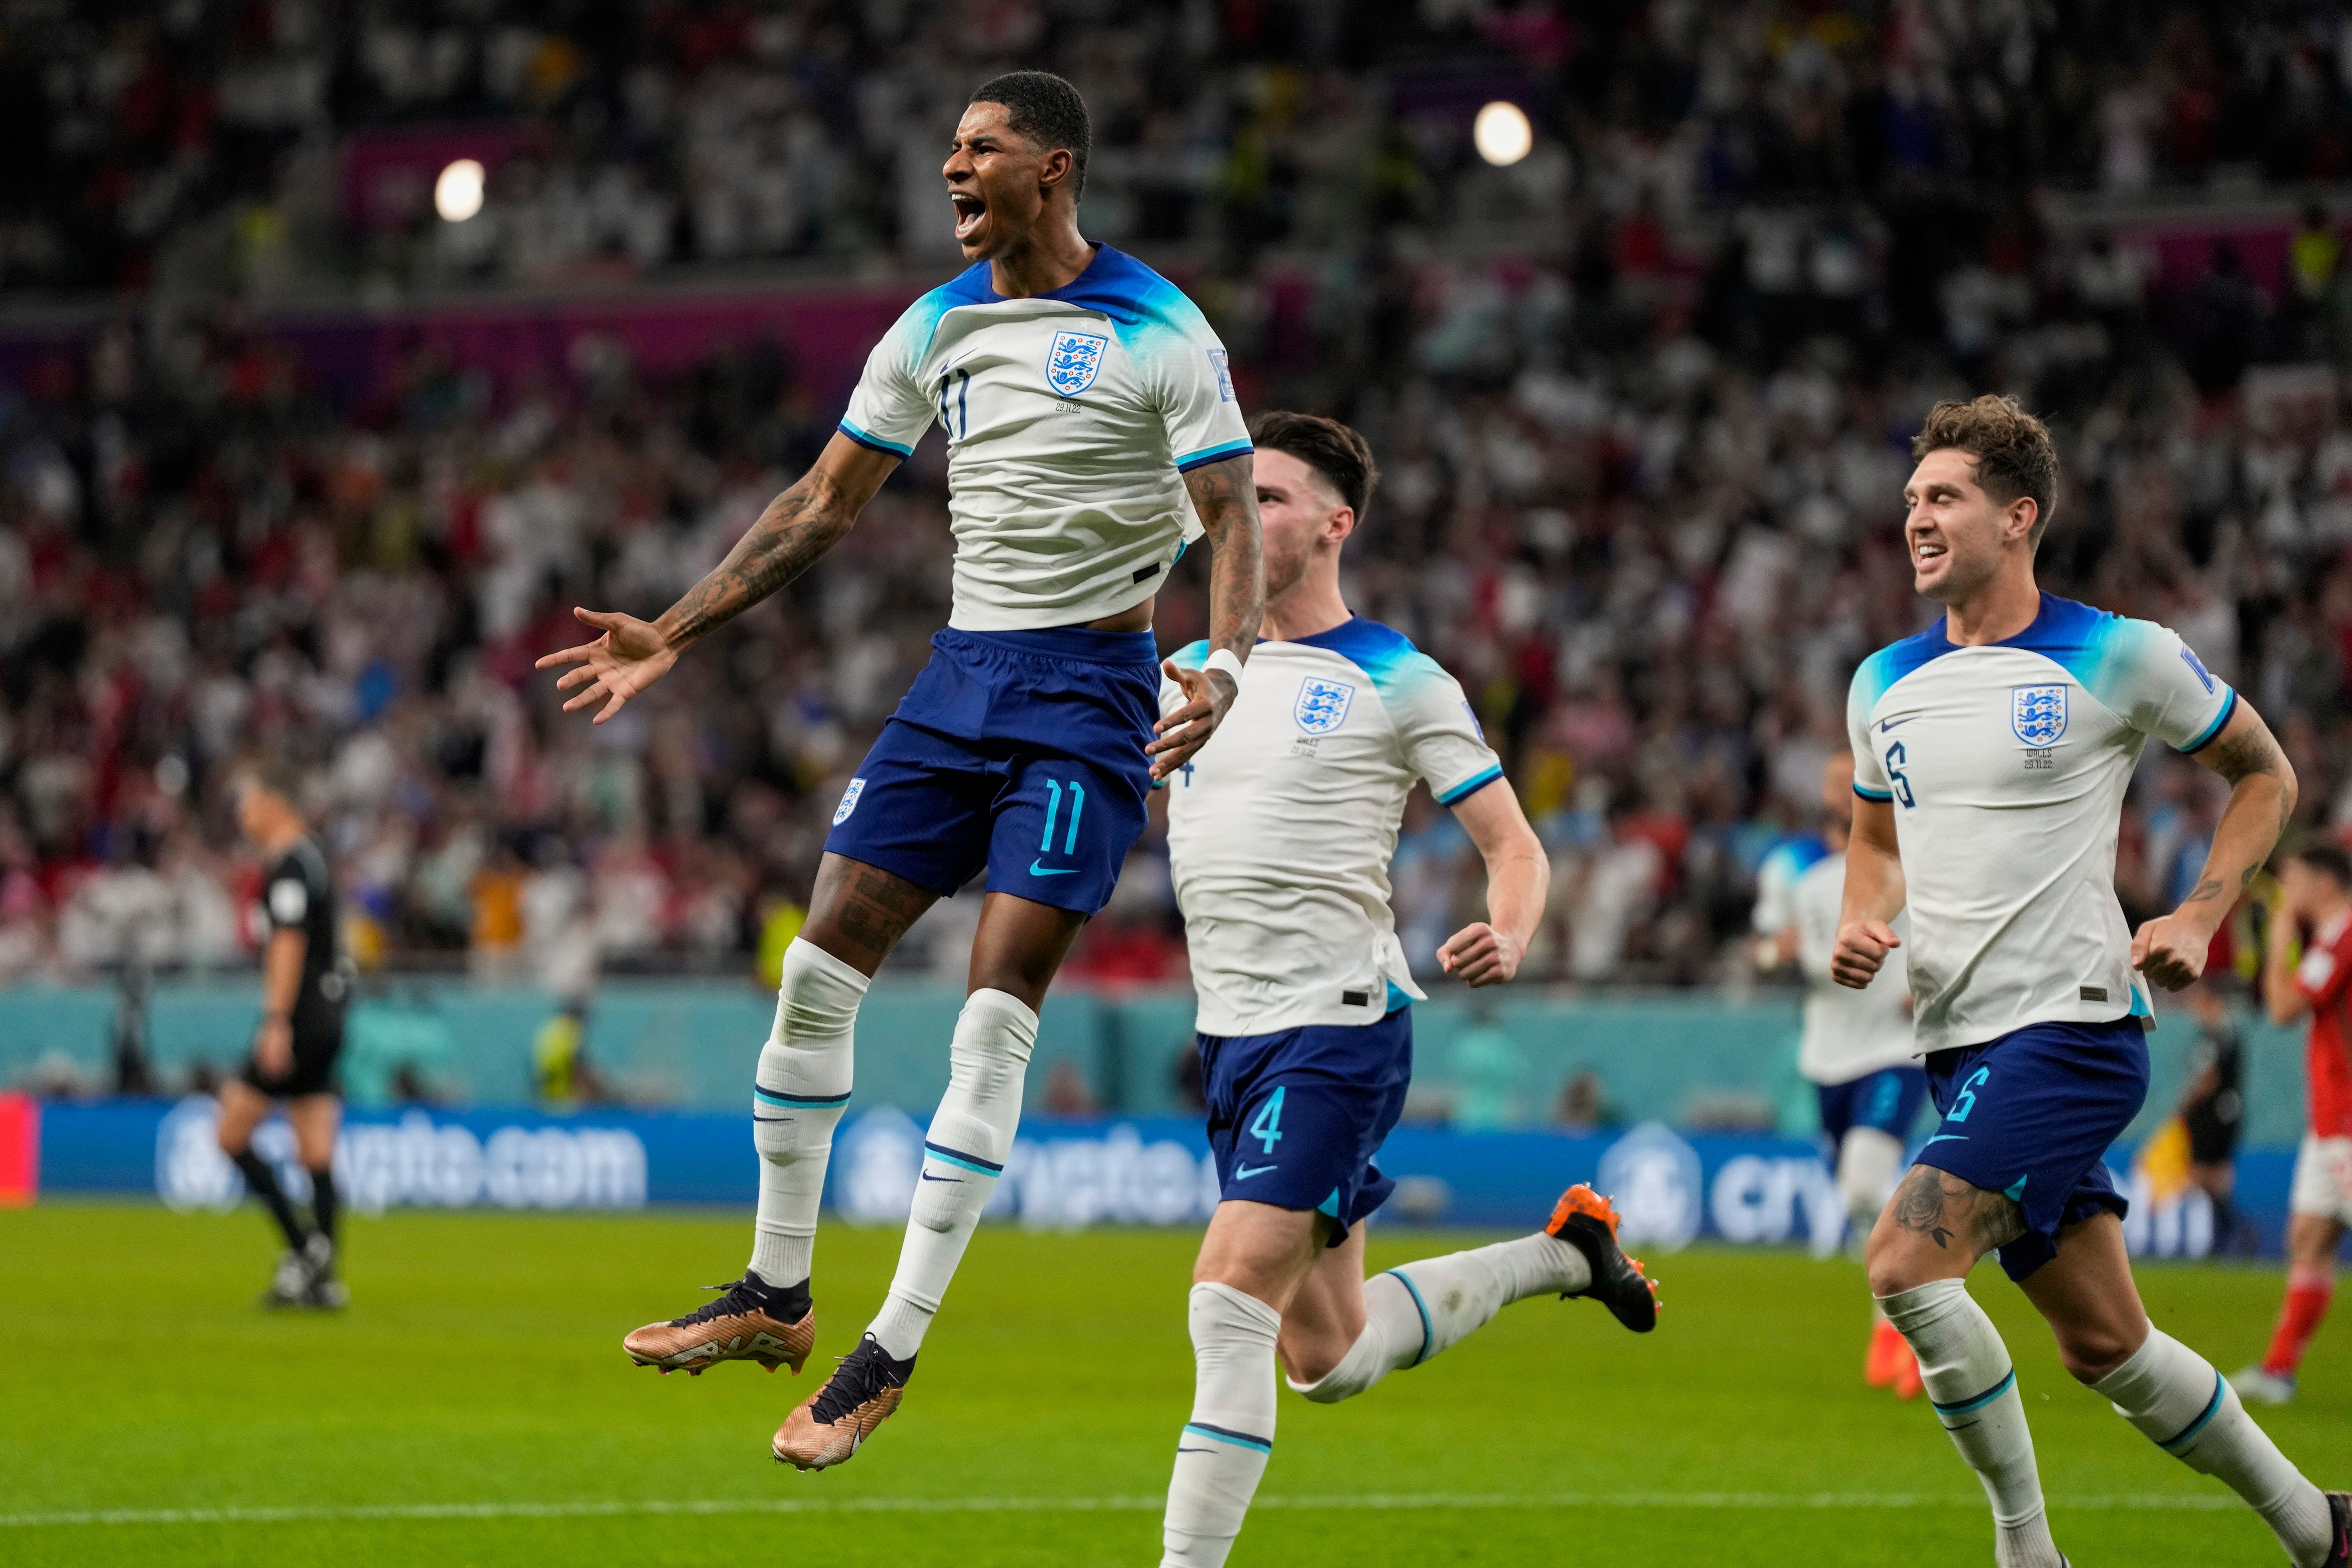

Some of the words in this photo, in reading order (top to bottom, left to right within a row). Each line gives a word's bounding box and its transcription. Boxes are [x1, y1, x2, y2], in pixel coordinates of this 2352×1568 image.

[941, 368, 970, 441] 11
[1055, 402, 1081, 414] 29.11.22
[2024, 760, 2052, 769] 29.11.22
[2026, 748, 2052, 757] WALES
[1041, 779, 1084, 855] 11
[1250, 1086, 1286, 1154] 4
